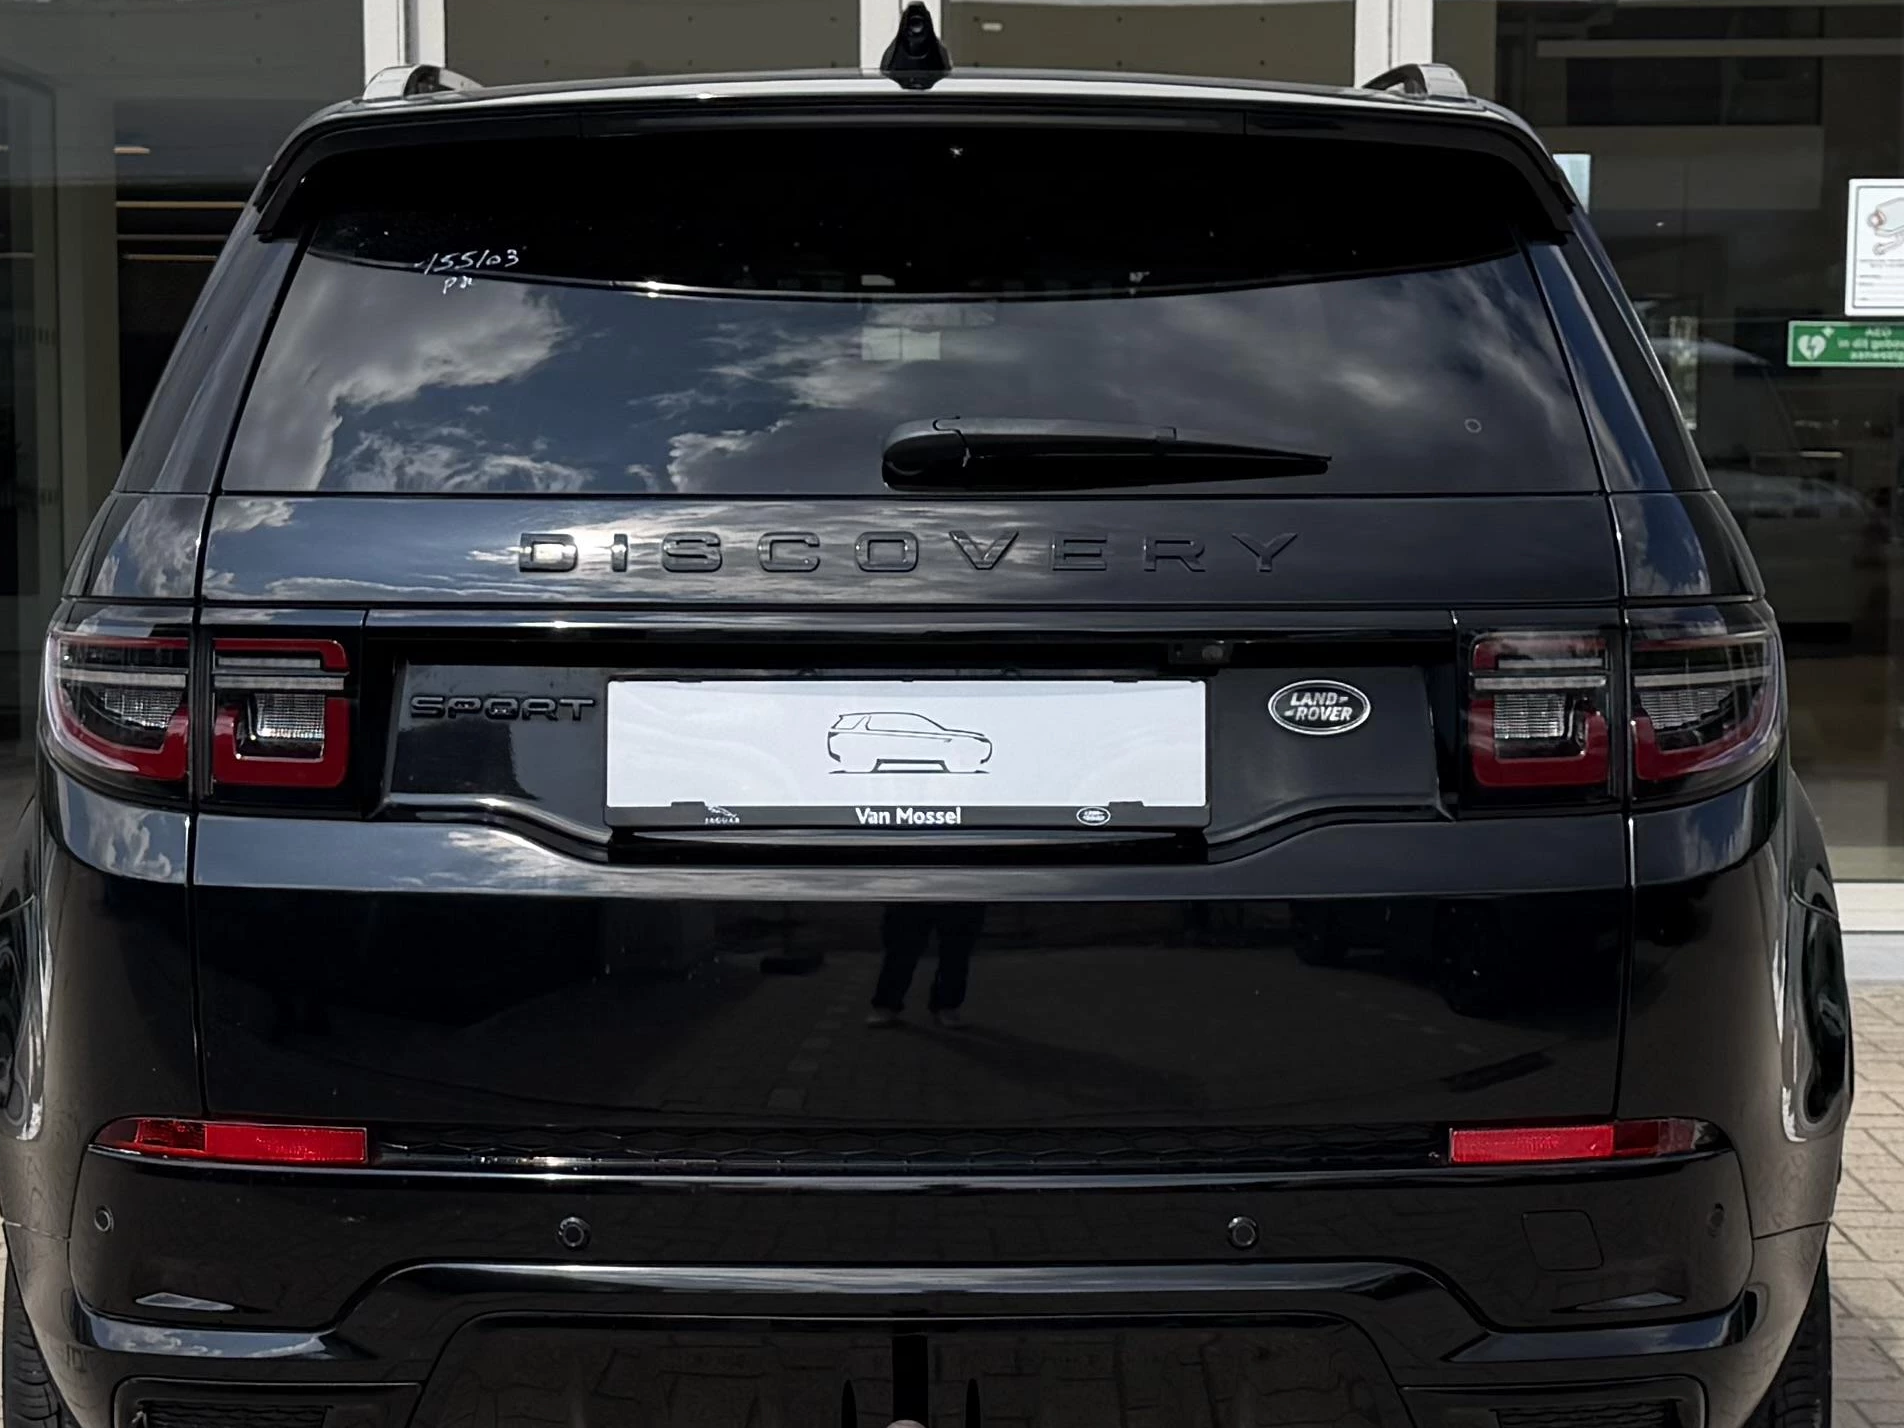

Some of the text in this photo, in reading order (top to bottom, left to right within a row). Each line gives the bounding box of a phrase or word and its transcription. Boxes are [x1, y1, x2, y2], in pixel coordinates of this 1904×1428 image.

[518, 531, 1298, 573] DISCOVERY
[410, 695, 595, 722] SPORT
[1290, 692, 1338, 706] LAND
[1295, 706, 1353, 721] ROVER
[855, 806, 962, 825] Van Mossel
